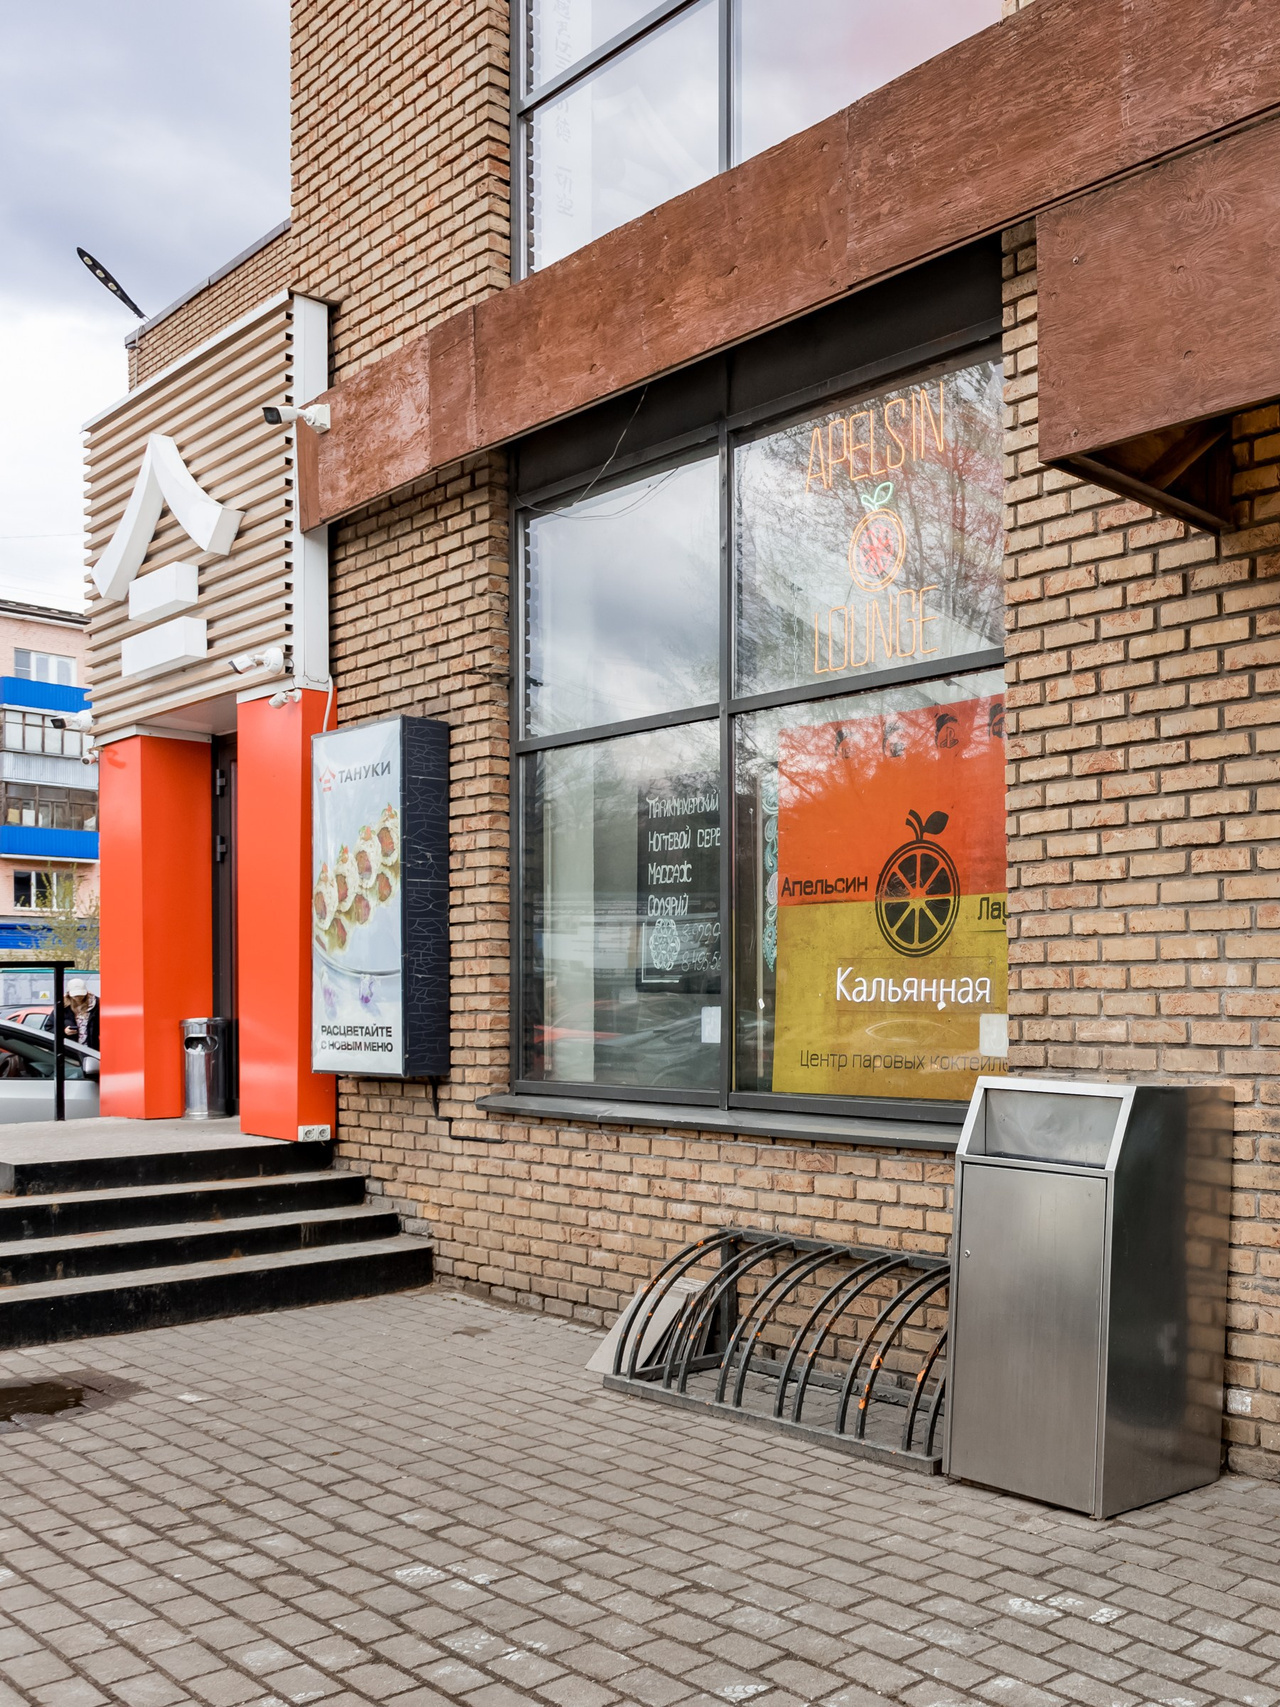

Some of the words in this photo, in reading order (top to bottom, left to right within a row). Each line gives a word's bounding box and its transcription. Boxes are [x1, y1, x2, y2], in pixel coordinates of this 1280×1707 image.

[805, 381, 944, 494] APELSIN
[814, 585, 938, 674] LOUNGE
[338, 760, 391, 783] ТАНУКИ
[648, 825, 692, 852] НОГТЕВОЙ
[781, 876, 868, 897] Апельсин
[836, 967, 991, 1003] Кальянная
[321, 1023, 392, 1038] РАСЦВЕТАЙТЕ
[321, 1040, 327, 1050] С
[328, 1040, 362, 1051] НОВЫМ
[363, 1041, 393, 1053] МЕНЮ
[799, 1050, 848, 1072] Центр
[852, 1053, 926, 1073] паровых
